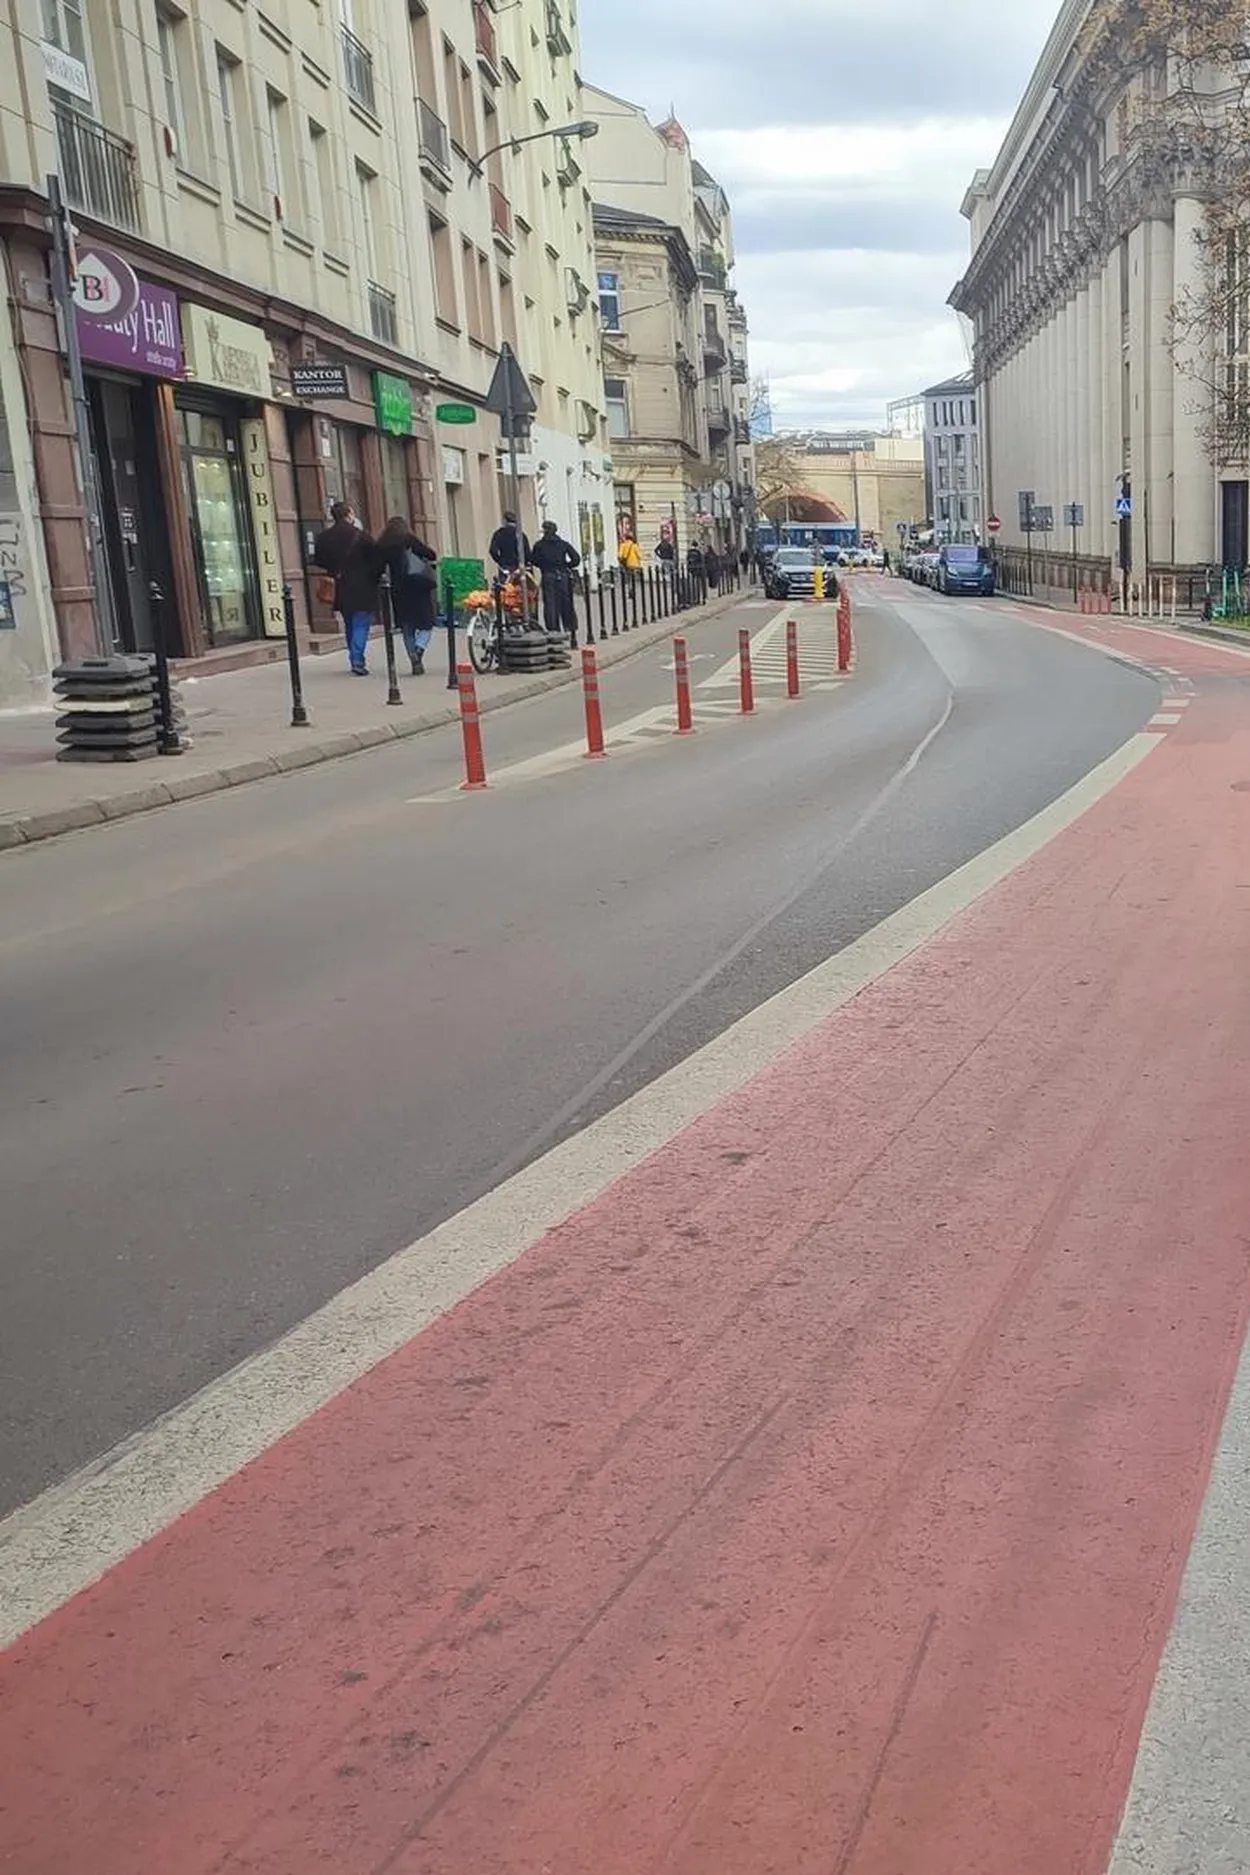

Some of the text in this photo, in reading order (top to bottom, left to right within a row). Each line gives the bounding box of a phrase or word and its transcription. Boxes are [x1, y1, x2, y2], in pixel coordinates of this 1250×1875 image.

[141, 299, 175, 349] Hall
[293, 369, 344, 380] KANTOR
[296, 385, 346, 395] EXCHANGE
[250, 433, 283, 623] JUBILER
